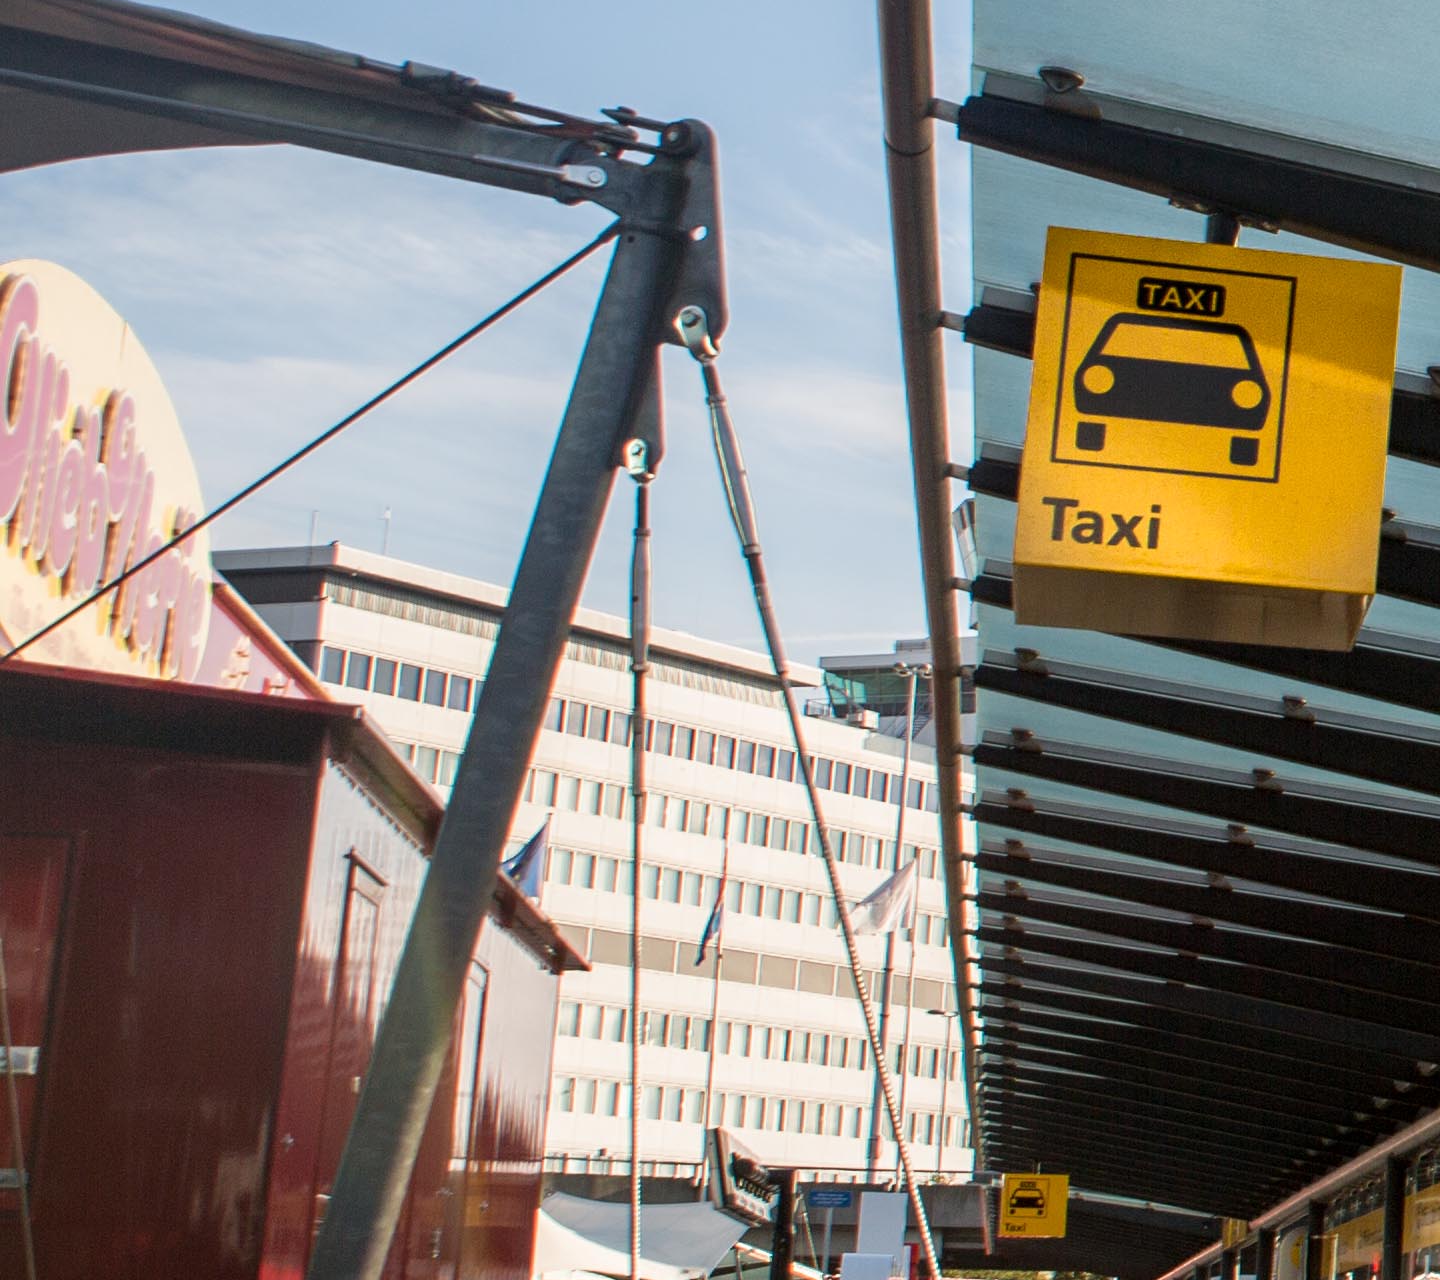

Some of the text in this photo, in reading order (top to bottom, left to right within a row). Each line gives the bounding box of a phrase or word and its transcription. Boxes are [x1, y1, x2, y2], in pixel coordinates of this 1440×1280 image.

[1143, 282, 1219, 313] TAXI
[1042, 496, 1161, 550] Taxi
[1005, 1222, 1026, 1232] Taxi
